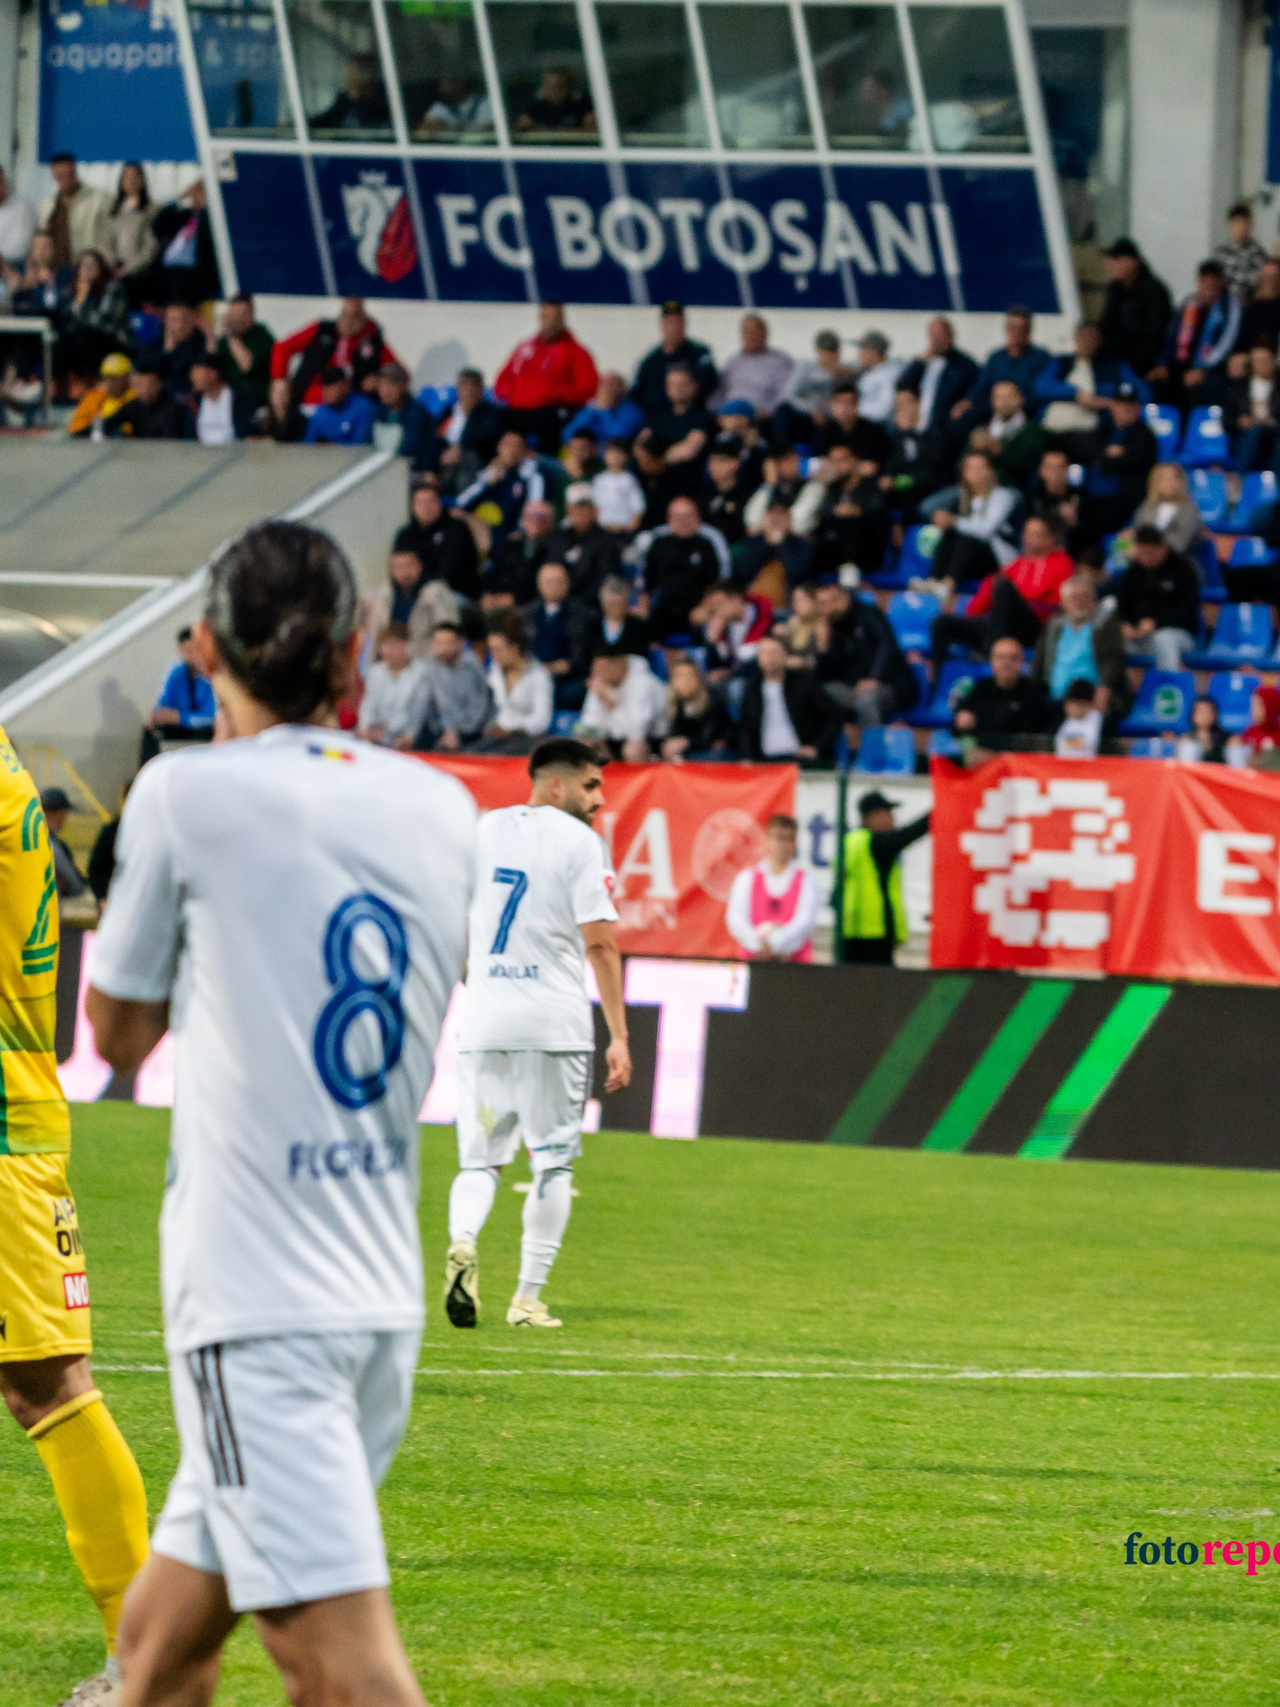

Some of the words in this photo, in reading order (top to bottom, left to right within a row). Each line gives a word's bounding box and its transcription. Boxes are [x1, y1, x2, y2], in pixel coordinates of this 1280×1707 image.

[48, 41, 186, 73] aquapar
[435, 193, 533, 272] FC
[545, 194, 962, 292] BOTOȘANI
[489, 866, 530, 956] 7
[312, 890, 410, 1111] 8
[53, 1197, 77, 1228] AP
[63, 1273, 91, 1309] NO
